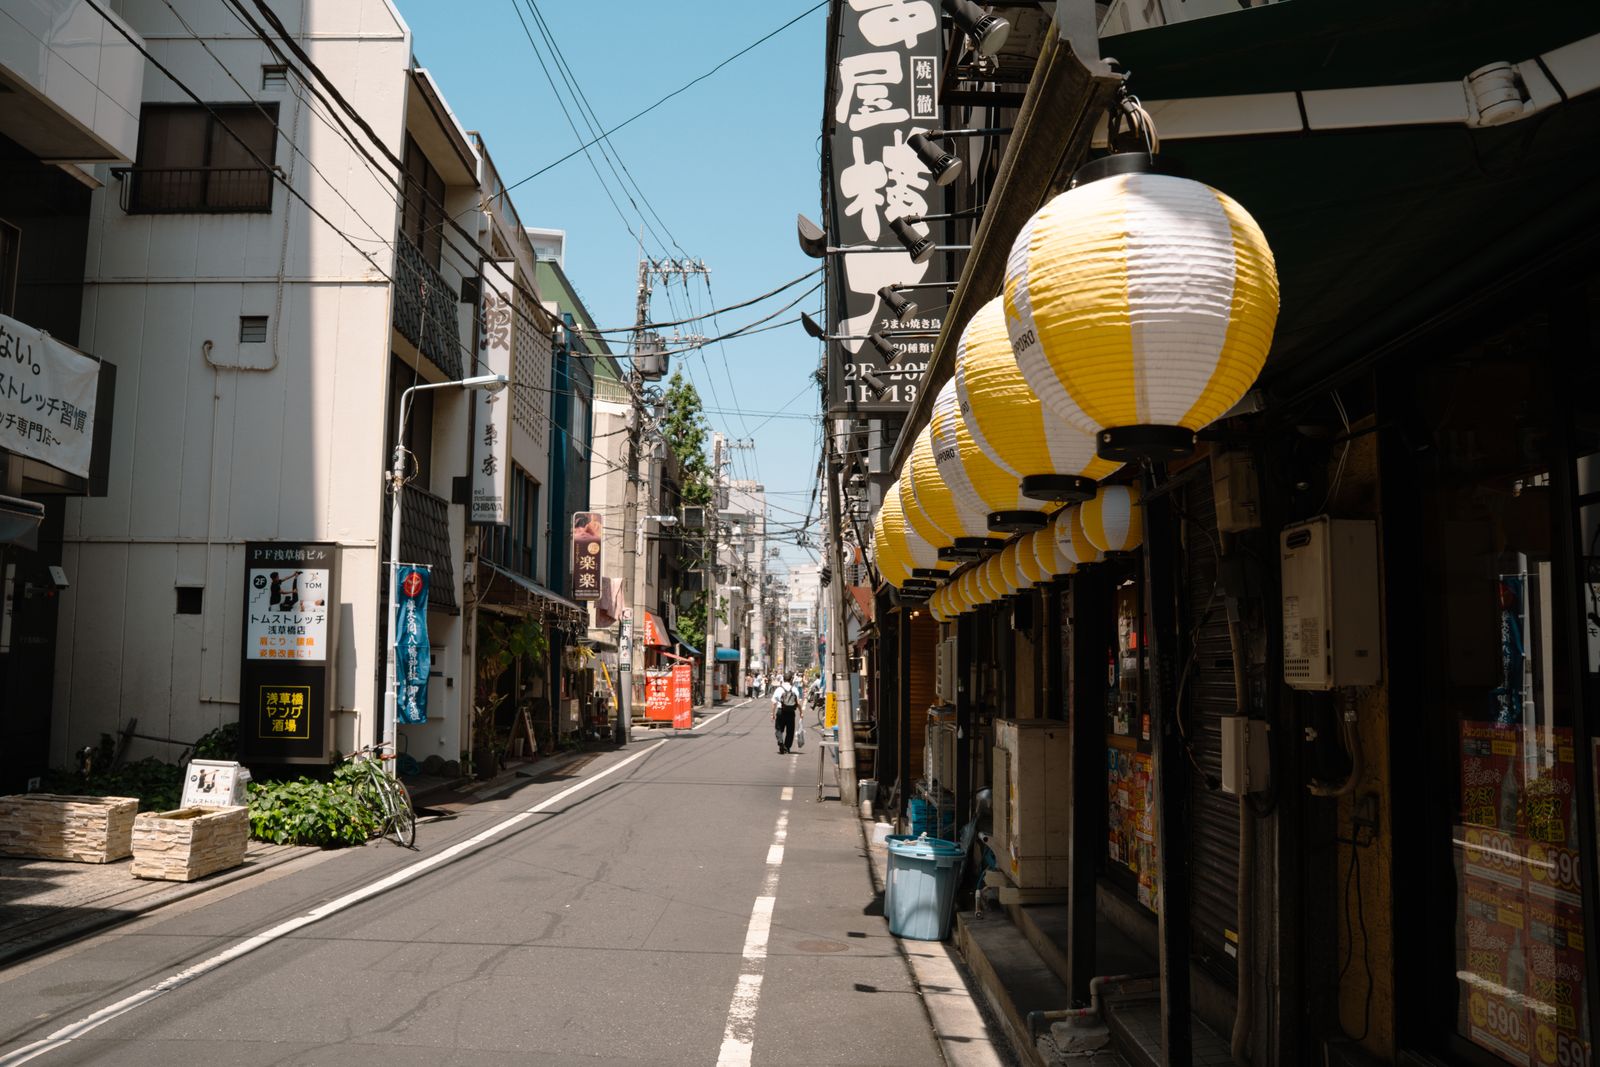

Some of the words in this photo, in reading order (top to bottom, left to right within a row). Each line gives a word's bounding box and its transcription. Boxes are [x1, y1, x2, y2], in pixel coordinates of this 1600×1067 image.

[916, 60, 933, 114] 焼一徹
[473, 502, 503, 512] CHIBAYA
[579, 555, 596, 588] 楽楽
[255, 577, 266, 586] 2F
[251, 614, 325, 625] トムストレッチ
[268, 625, 306, 635] 浅草橋店
[266, 692, 304, 706] 浅草橋
[266, 706, 303, 719] ヤング
[272, 719, 297, 732] 酒場
